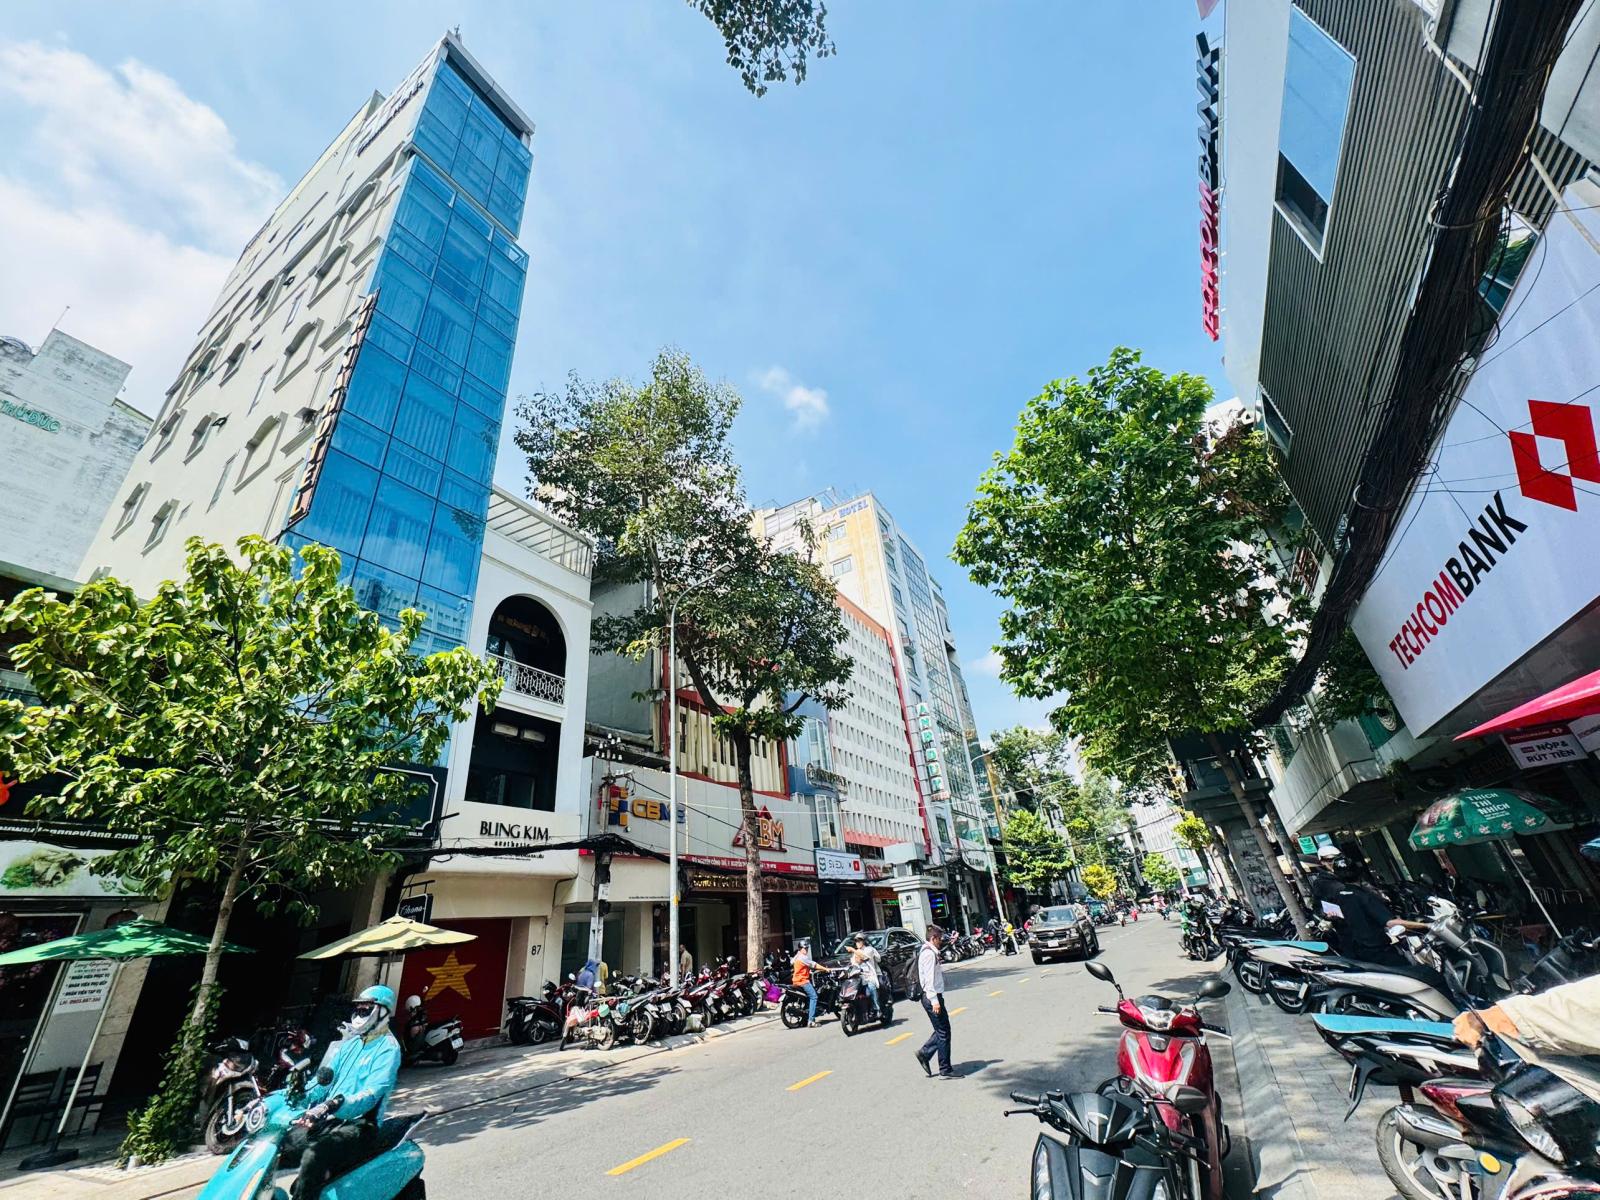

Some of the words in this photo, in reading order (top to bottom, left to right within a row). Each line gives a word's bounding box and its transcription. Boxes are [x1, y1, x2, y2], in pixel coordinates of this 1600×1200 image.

[1196, 32, 1220, 342] TECHCOMBANK
[1389, 490, 1528, 670] TECHCOMBANK
[1526, 752, 1548, 763] RÚT
[1465, 792, 1499, 801] THÍCH
[1478, 803, 1511, 815] NHÍCH
[480, 820, 520, 839] BLING
[523, 825, 549, 842] KIM
[531, 944, 541, 955] 87
